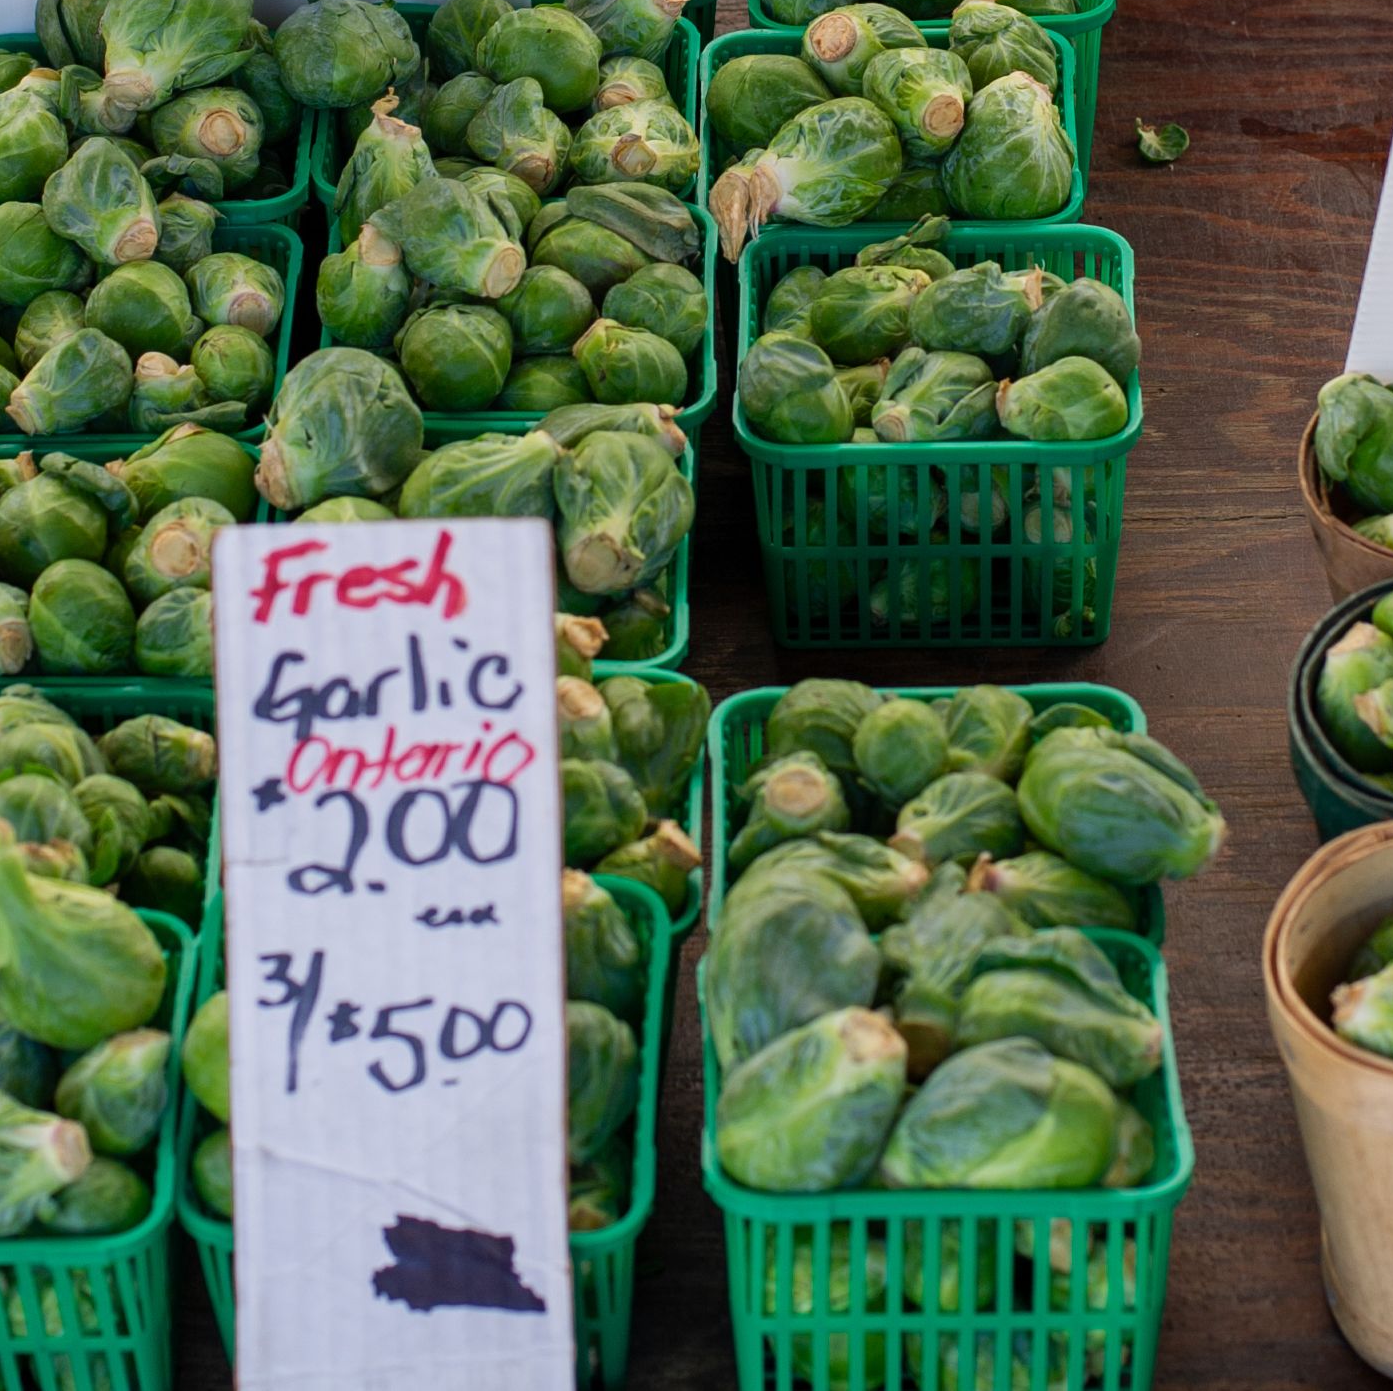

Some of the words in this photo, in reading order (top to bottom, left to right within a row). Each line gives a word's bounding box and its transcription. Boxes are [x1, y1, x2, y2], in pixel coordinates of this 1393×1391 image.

[249, 529, 467, 625] Fresh
[254, 635, 522, 741] Garlic
[285, 720, 537, 795] Ontario
